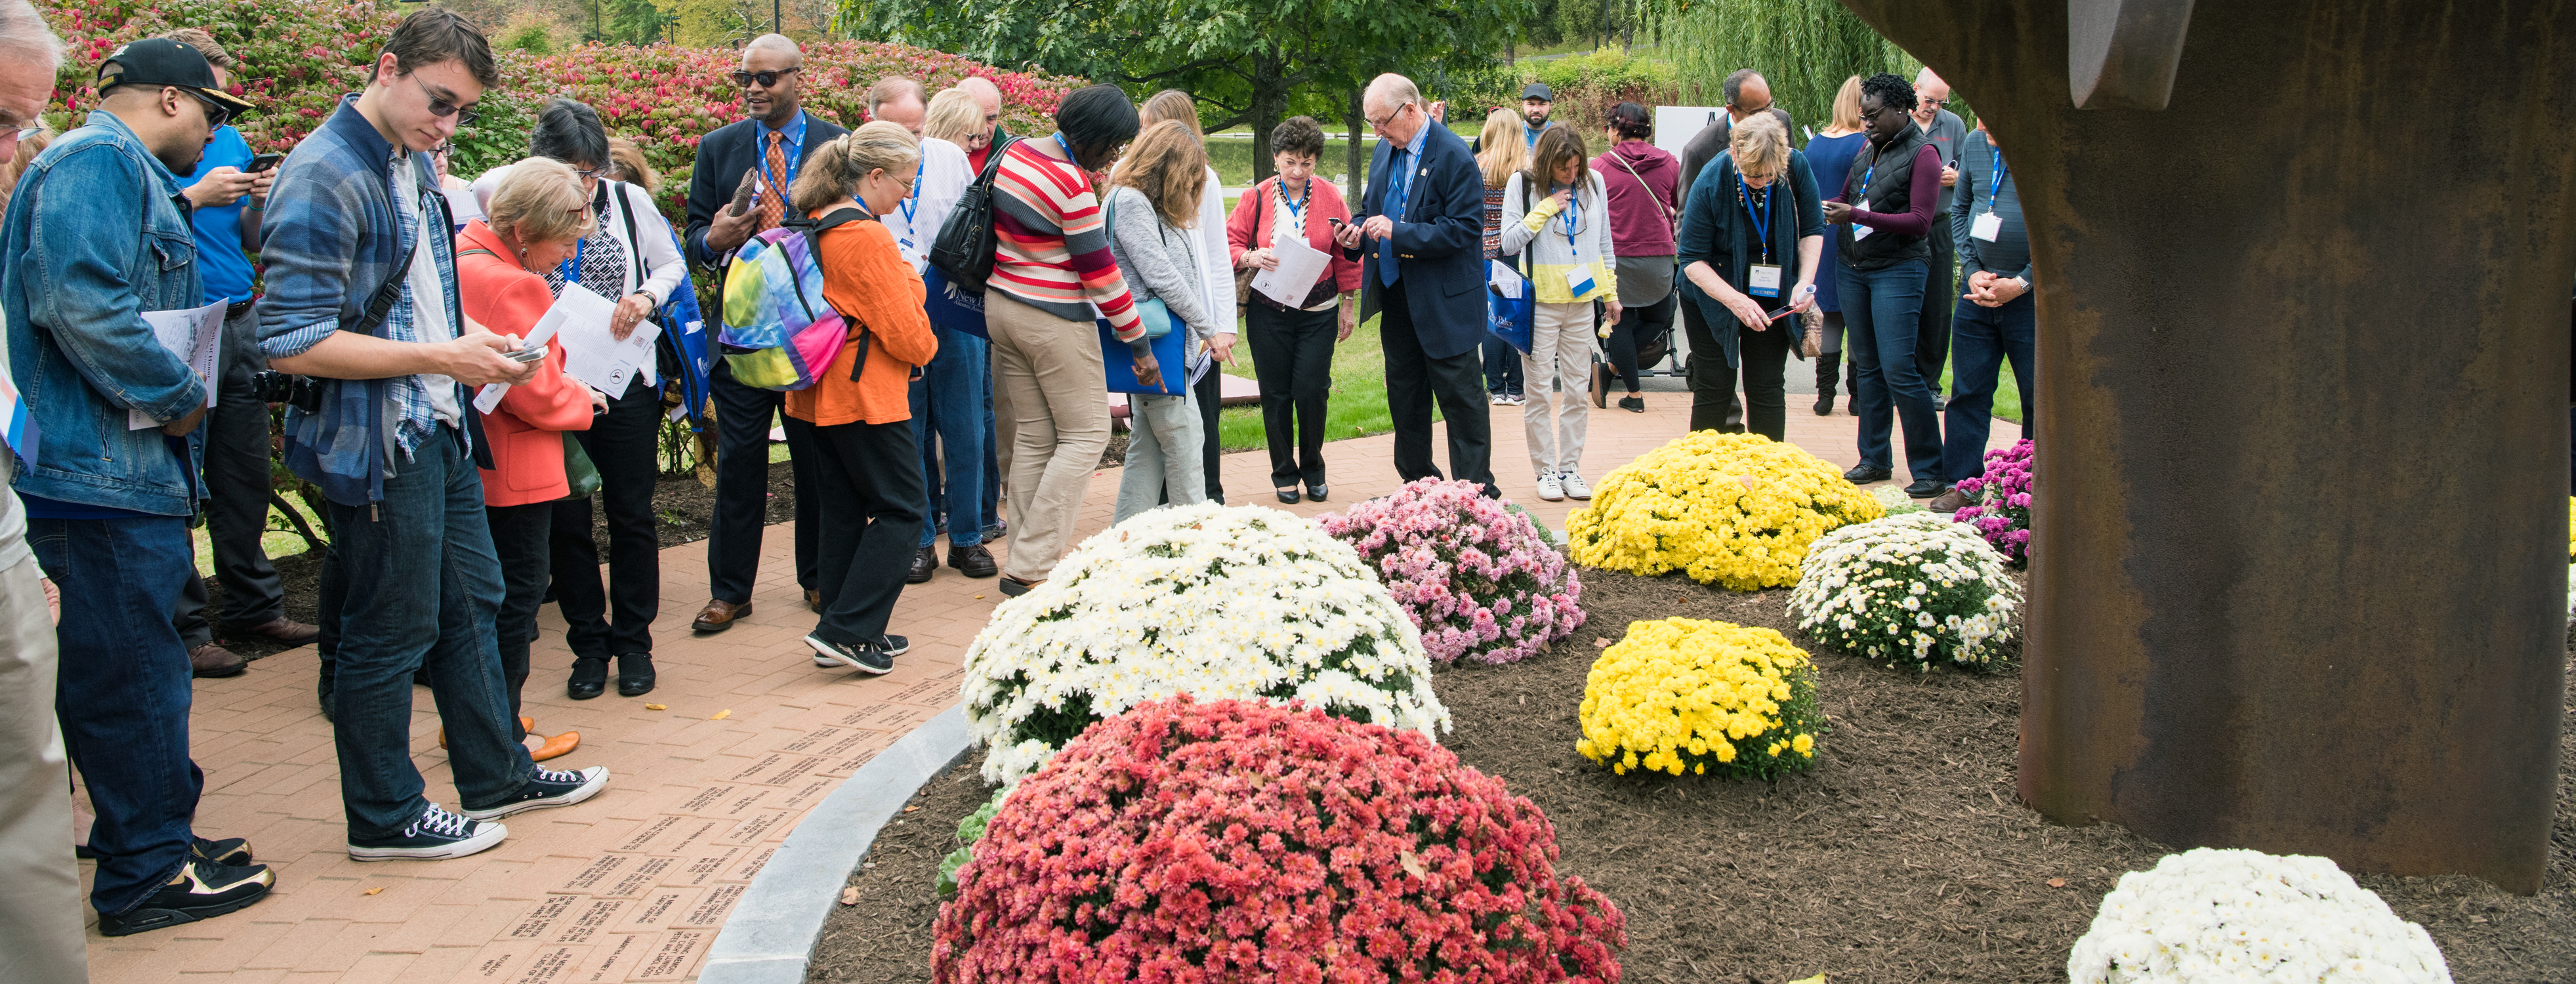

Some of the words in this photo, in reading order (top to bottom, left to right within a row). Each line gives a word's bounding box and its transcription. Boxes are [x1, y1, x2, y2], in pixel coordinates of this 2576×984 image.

[956, 289, 977, 304] New
[953, 299, 970, 309] Alumni
[1498, 315, 1513, 327] Paltz
[209, 344, 214, 354] Of
[852, 748, 875, 760] GRADUATE
[743, 754, 778, 773] VALEDICTORIAN
[694, 787, 717, 800] BELOVED
[715, 786, 734, 797] MAGGIE
[796, 782, 821, 796] GRADUATE
[691, 789, 722, 808] CALCATERRA
[733, 797, 751, 806] PEACE
[750, 790, 770, 802] EVELYN
[680, 800, 695, 809] PUPS
[692, 801, 711, 811] OSCAR
[649, 816, 673, 830] POLITICAL
[665, 817, 681, 827] REGINA
[749, 814, 767, 825] CLASS
[764, 811, 787, 827] KATHRYN
[629, 831, 652, 844] SCIENCE
[639, 827, 666, 844] CALCATERRA
[741, 827, 767, 844] FARINACCI
[672, 840, 690, 852] DUTKA
[757, 848, 774, 859] CLASS
[594, 855, 613, 866] RENEE
[594, 857, 618, 873] MARISSA
[606, 857, 627, 871] JESSICA
[636, 858, 657, 872] ANTHONY
[643, 859, 665, 874] HUSBAND
[651, 862, 670, 875] MEMORY
[563, 880, 577, 889] 2011
[576, 874, 596, 886] PETTIT
[583, 872, 608, 888] FERRARA
[614, 873, 638, 890] CATALANO
[692, 873, 709, 884] GREER
[616, 882, 636, 895] FATHER
[624, 884, 642, 896] LOVING
[721, 885, 736, 899] HUMILITY
[731, 886, 745, 897] PEDRO
[563, 896, 577, 905] DEAR
[655, 895, 669, 905] CARY
[703, 888, 724, 905] LEARNING
[530, 905, 547, 918] JAMES
[545, 903, 560, 914] MARY
[549, 906, 567, 918] FRIEND
[608, 901, 623, 911] GAYLE
[654, 899, 674, 916] MEMORY
[713, 897, 734, 915] GONZALEZ
[576, 909, 596, 926] CONNECT
[594, 912, 610, 926] JACOBS
[687, 911, 702, 922] LIVING
[694, 904, 718, 925] CONFIDENCE
[510, 924, 528, 936] BRAIN
[524, 920, 542, 933] BOYLE
[530, 922, 549, 937] MENTOR
[568, 928, 586, 941] ATTAIN
[669, 931, 684, 943] PETER
[613, 935, 635, 955] SAMANTHA
[671, 940, 686, 954] CATHY
[680, 939, 697, 954] LOVING
[533, 953, 552, 968] CLASS
[546, 948, 568, 966] MARJORIE
[600, 956, 617, 971] CARNEY
[651, 953, 667, 965] CAROL
[480, 960, 495, 971] NOVI
[484, 954, 511, 976] ROSALOU
[545, 960, 567, 979] MEMORY
[641, 966, 655, 977] GOSS
[666, 956, 684, 974] MEMORY
[530, 967, 550, 983] MIHALKO
[590, 972, 603, 981] 2016
